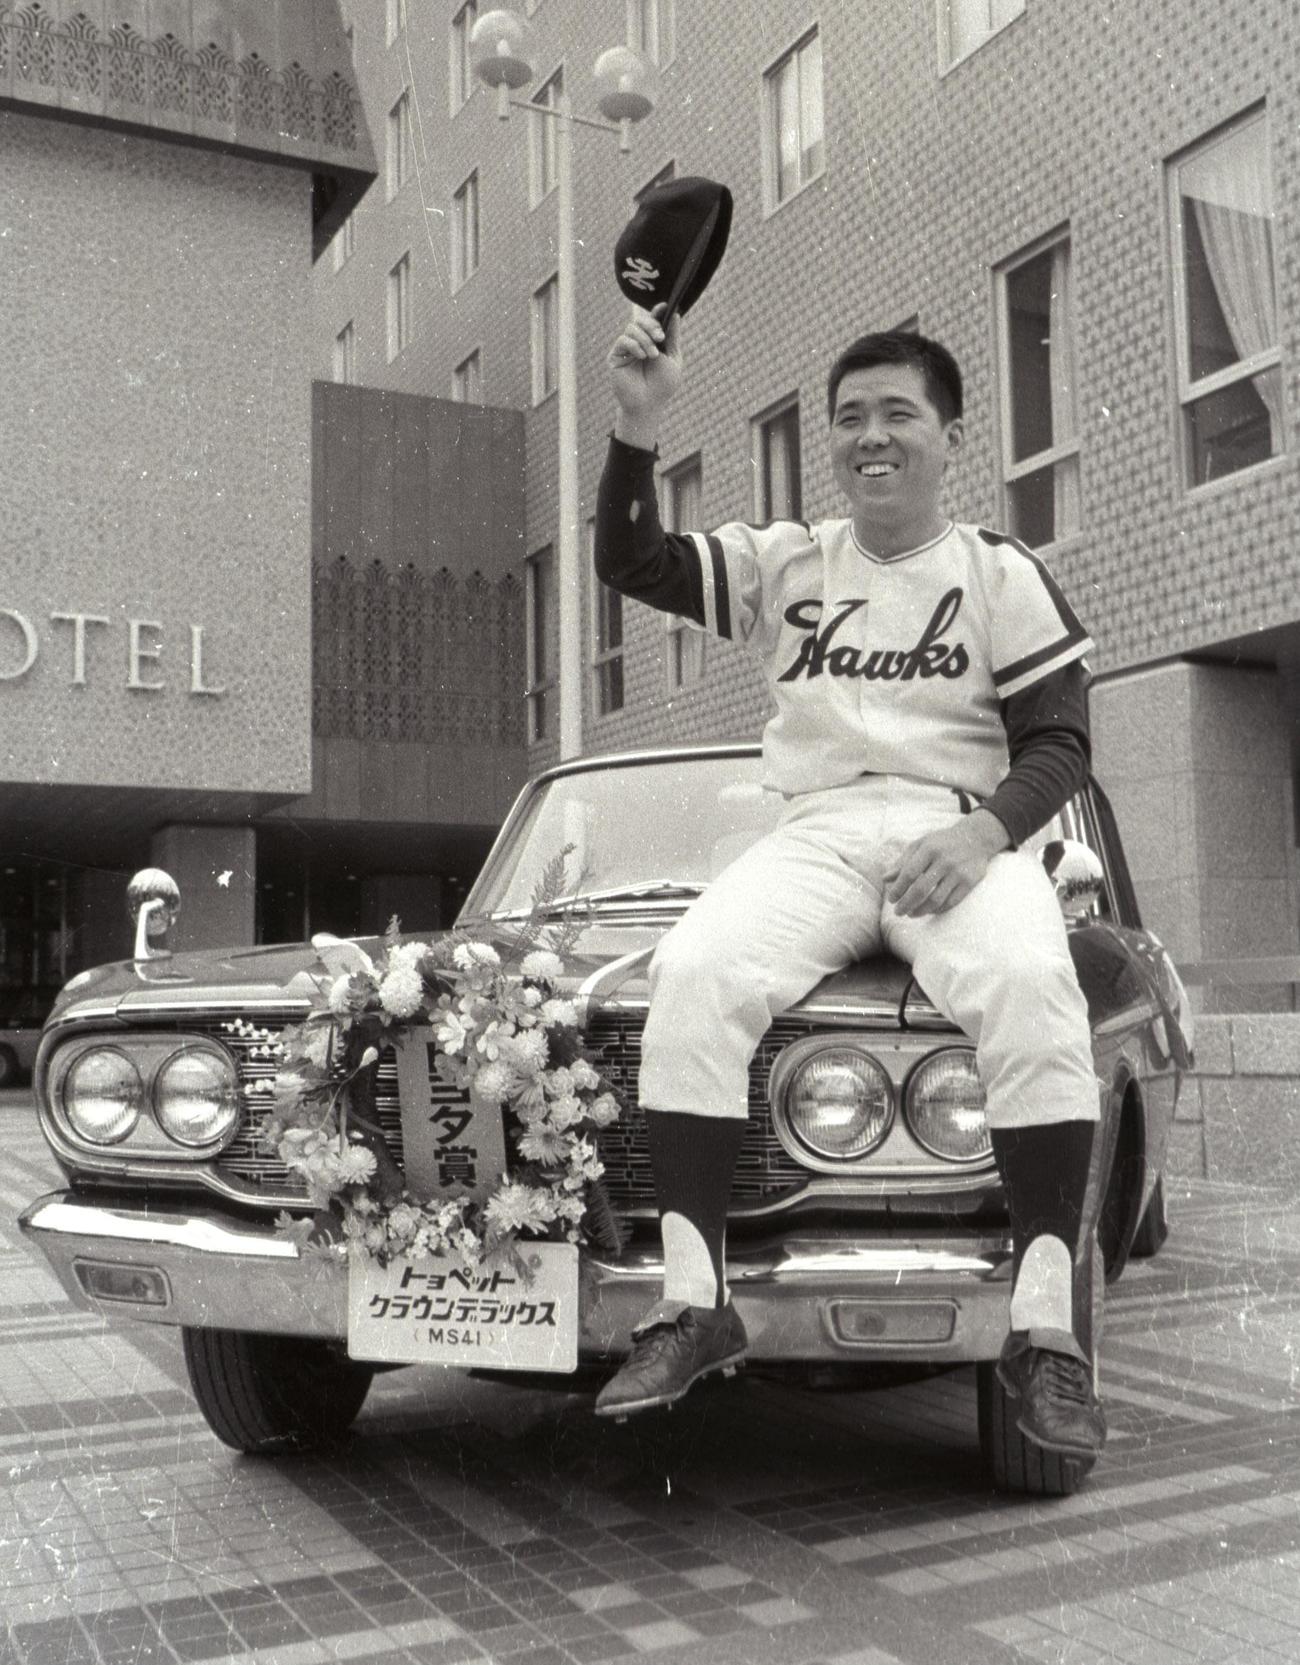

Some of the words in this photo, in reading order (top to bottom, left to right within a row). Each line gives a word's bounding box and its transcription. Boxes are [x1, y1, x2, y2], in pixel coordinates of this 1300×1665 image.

[777, 586, 970, 682] Hawks
[369, 1294, 557, 1326] クラウンデラックス
